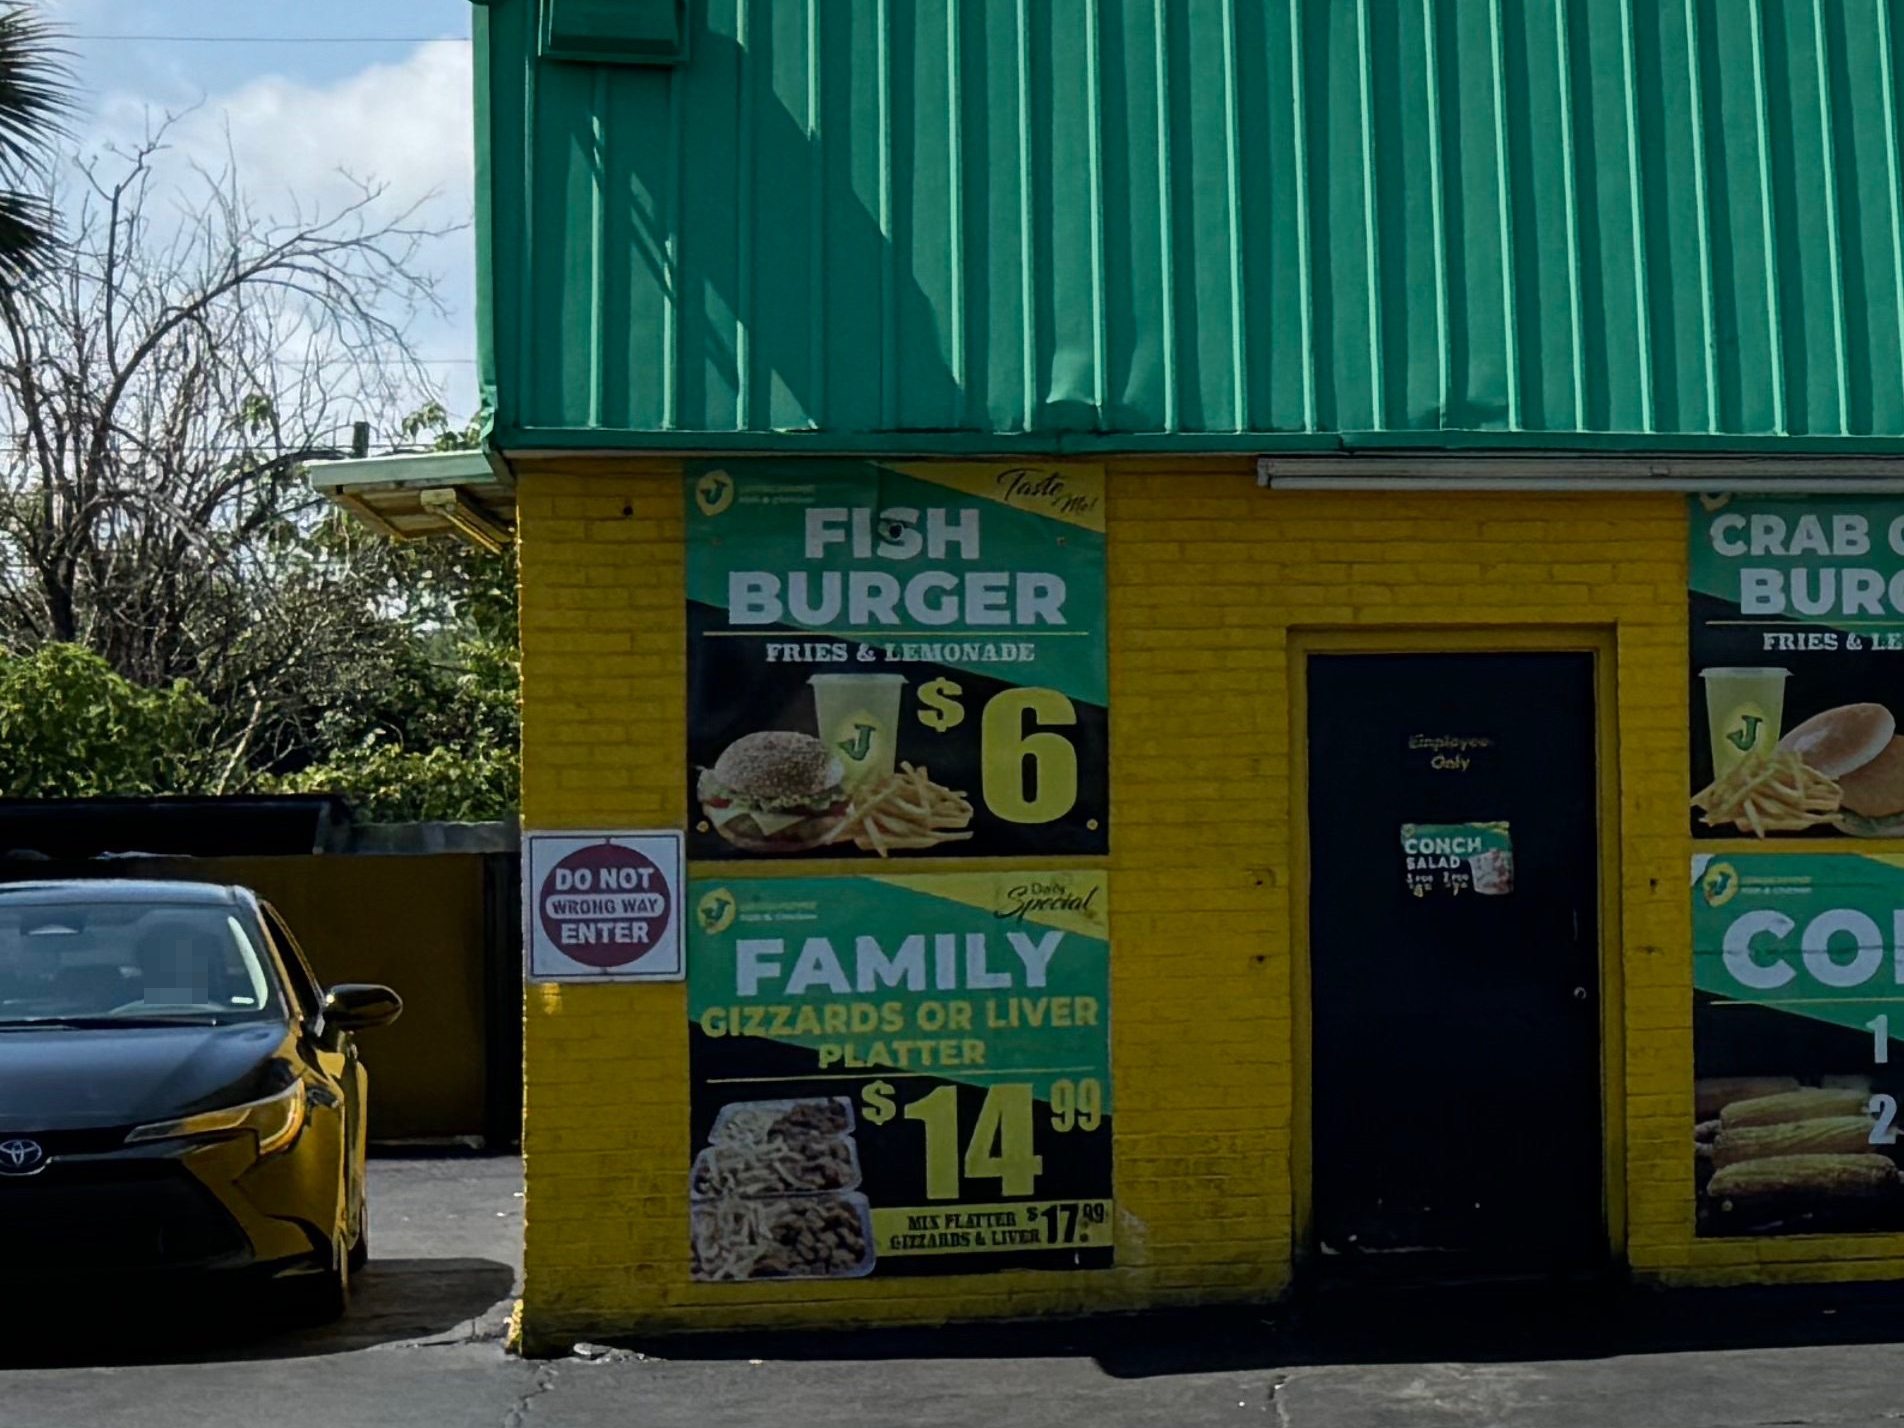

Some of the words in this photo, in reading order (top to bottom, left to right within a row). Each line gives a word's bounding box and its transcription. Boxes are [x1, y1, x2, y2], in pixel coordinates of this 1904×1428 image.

[997, 468, 1064, 499] Taste
[805, 507, 981, 560] FISH
[1710, 514, 1871, 557] CRAB
[729, 572, 1067, 626] BURGER
[766, 644, 848, 663] FRIES
[856, 644, 876, 662] &
[886, 643, 1035, 662] LEMONADE
[1763, 633, 1838, 651] FRIES
[1846, 633, 1862, 651] &
[1431, 754, 1470, 771] Only
[1404, 837, 1482, 854] CONCH
[1406, 856, 1460, 871] SALAD
[554, 869, 592, 891] DO
[599, 868, 654, 890] NOT
[552, 897, 615, 916] WRONG
[621, 896, 659, 914] WAY
[994, 886, 1099, 923] Special
[561, 922, 649, 945] ENTER
[736, 930, 1066, 996] FAMILY
[701, 1004, 903, 1038] GIZZARDS
[918, 1001, 972, 1030] OR
[986, 996, 1098, 1028] LIVER
[1866, 1014, 1888, 1063] 1
[818, 1039, 986, 1070] PLATTER
[1868, 1093, 1897, 1144] 2
[908, 1215, 939, 1230] MIX
[945, 1212, 1016, 1230] PLATTER
[891, 1232, 970, 1249] GIZZARDS
[975, 1231, 986, 1245] &
[992, 1229, 1040, 1245] LIVER
